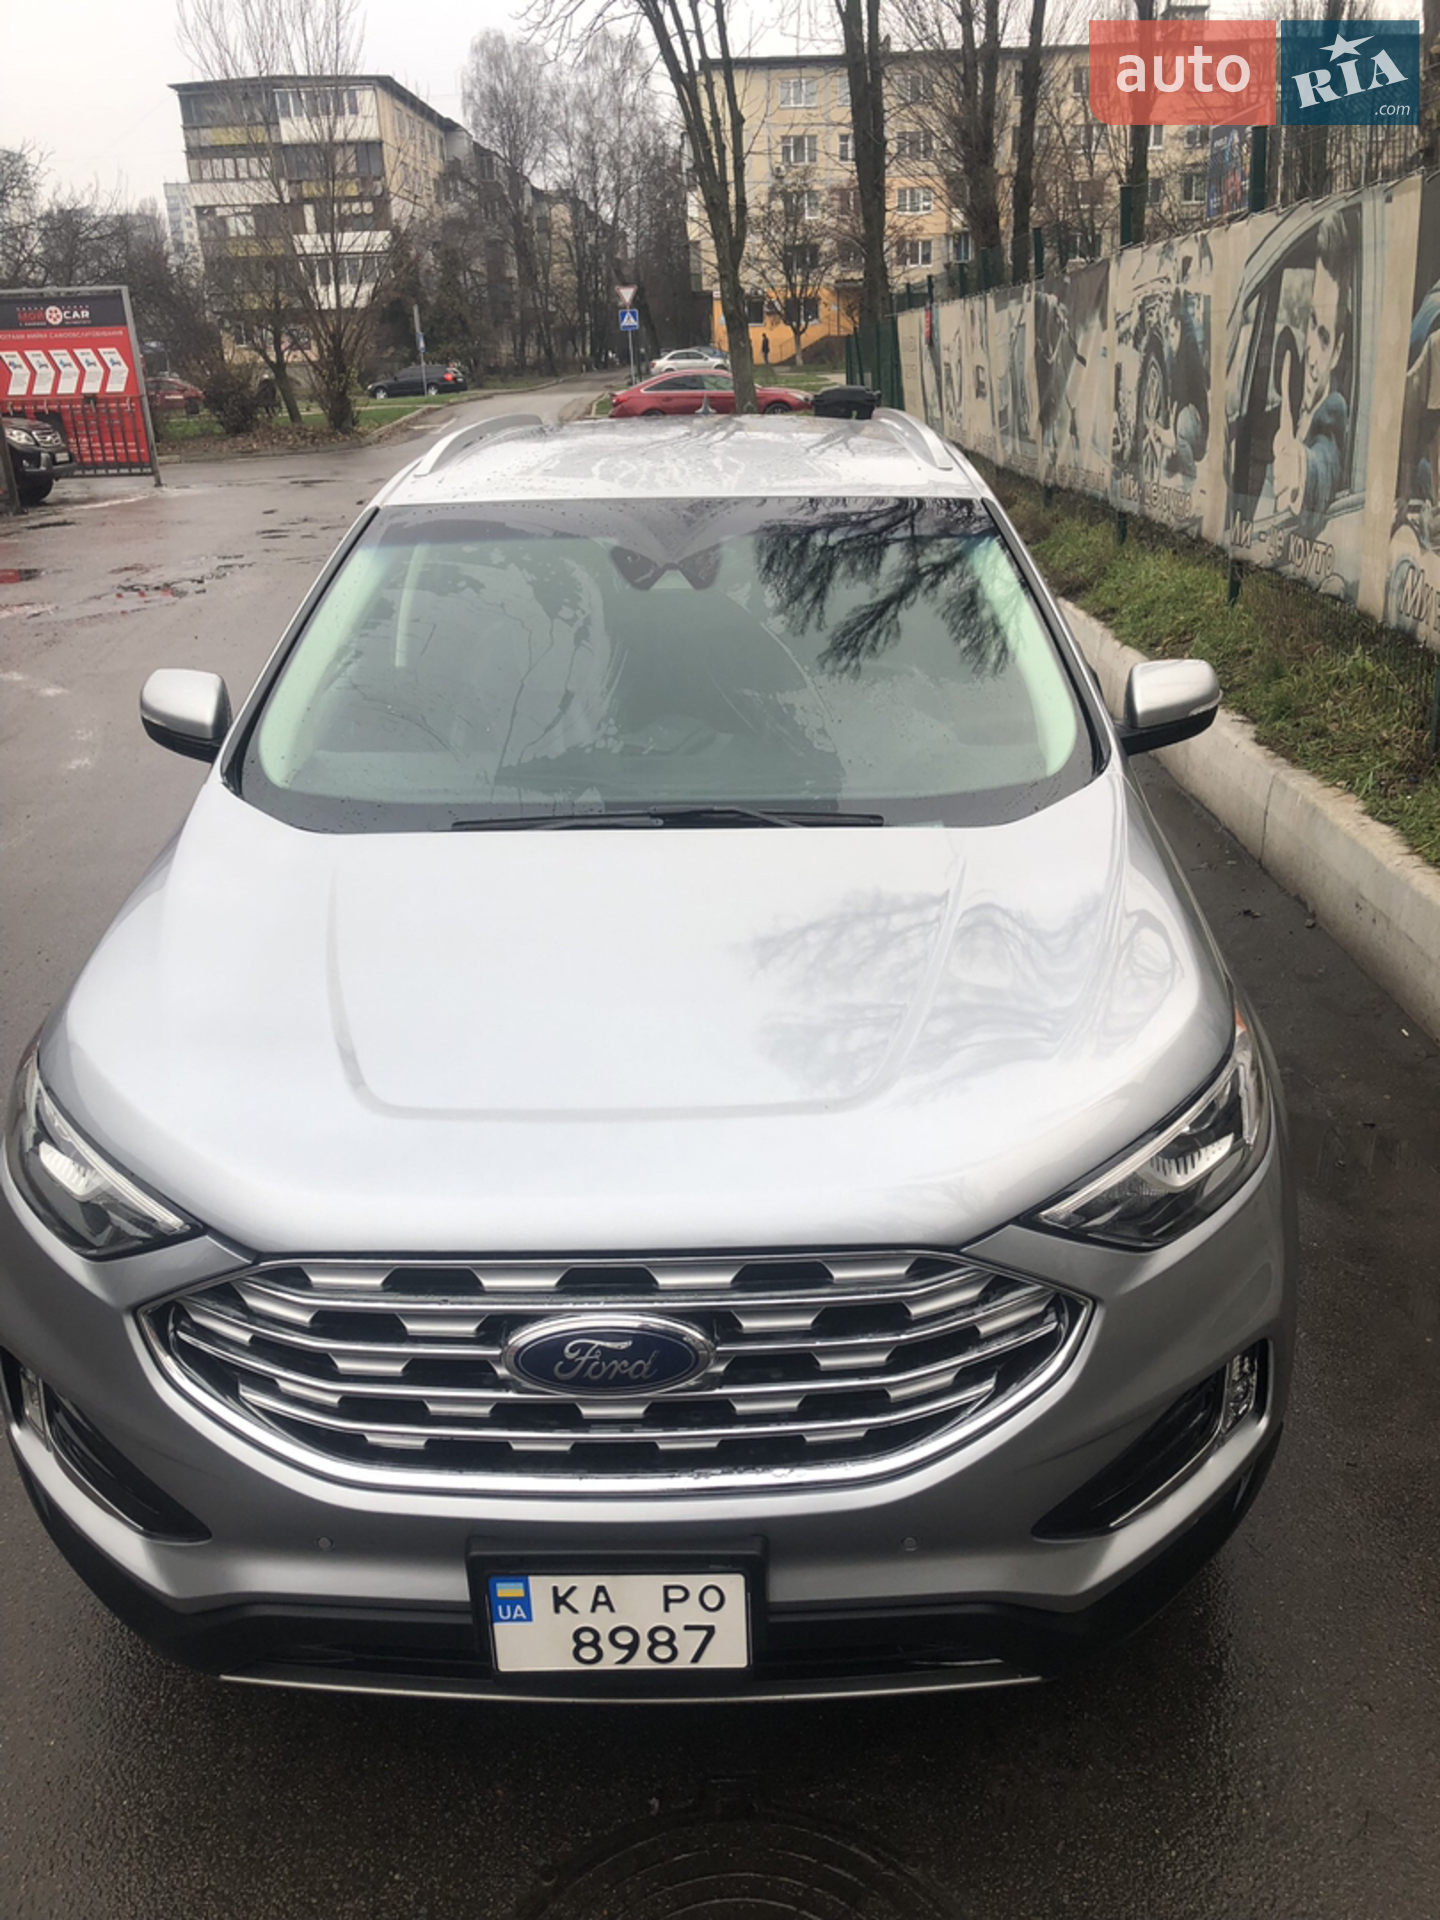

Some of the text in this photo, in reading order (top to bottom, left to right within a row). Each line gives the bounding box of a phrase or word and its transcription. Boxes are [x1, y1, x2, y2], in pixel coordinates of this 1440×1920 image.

[63, 310, 90, 319] CAR
[553, 1338, 661, 1381] Ford
[497, 1604, 527, 1620] UA
[551, 1585, 616, 1614] KA
[572, 1625, 716, 1665] 8987
